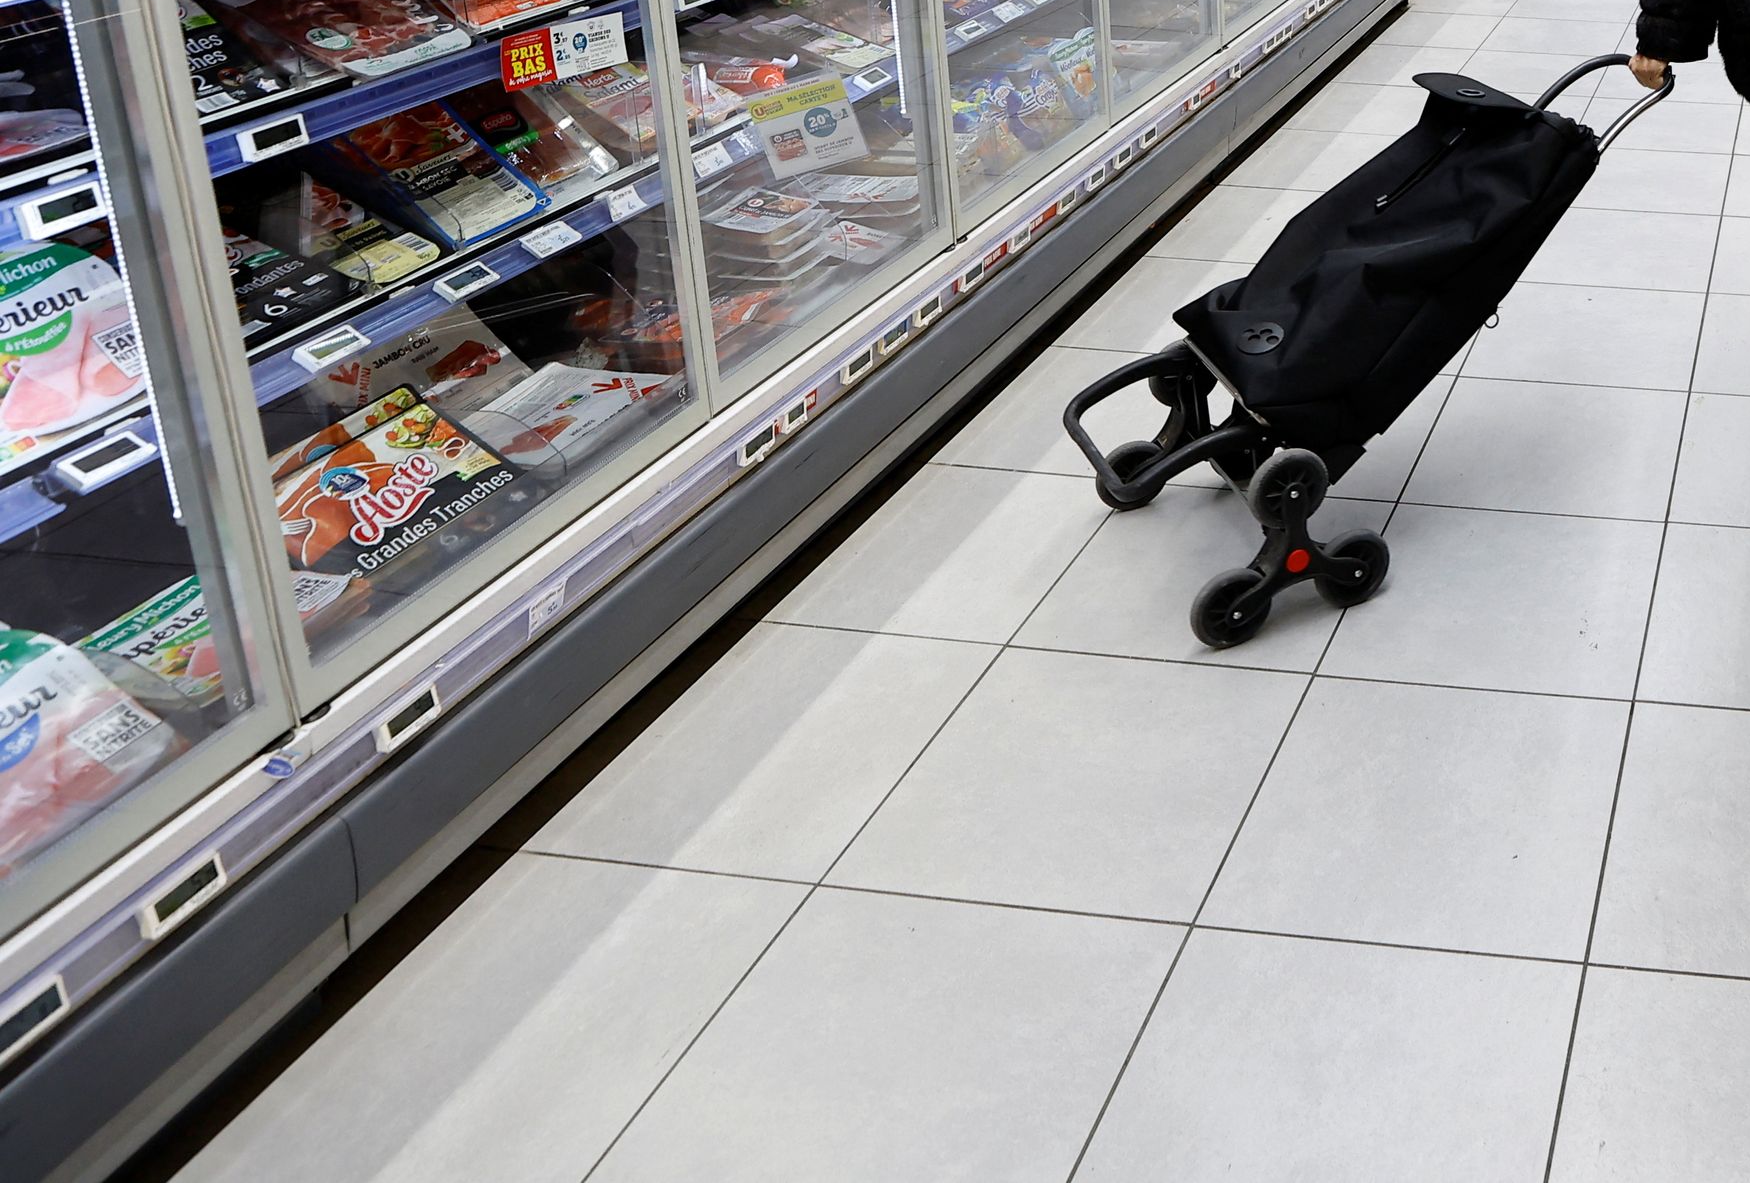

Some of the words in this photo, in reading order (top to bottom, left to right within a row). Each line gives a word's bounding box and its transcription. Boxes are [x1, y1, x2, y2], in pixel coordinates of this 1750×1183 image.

[511, 43, 545, 62] PRIX
[512, 56, 547, 78] BAS
[583, 73, 615, 88] Herta
[583, 75, 641, 101] Salami
[236, 259, 305, 295] ondantes
[104, 332, 138, 357] SAN
[373, 342, 412, 369] JAMBON
[411, 334, 431, 350] CRU
[349, 453, 438, 546] Aoste
[356, 517, 438, 571] Grandes
[430, 468, 514, 526] Tranches
[140, 584, 201, 626] Michon
